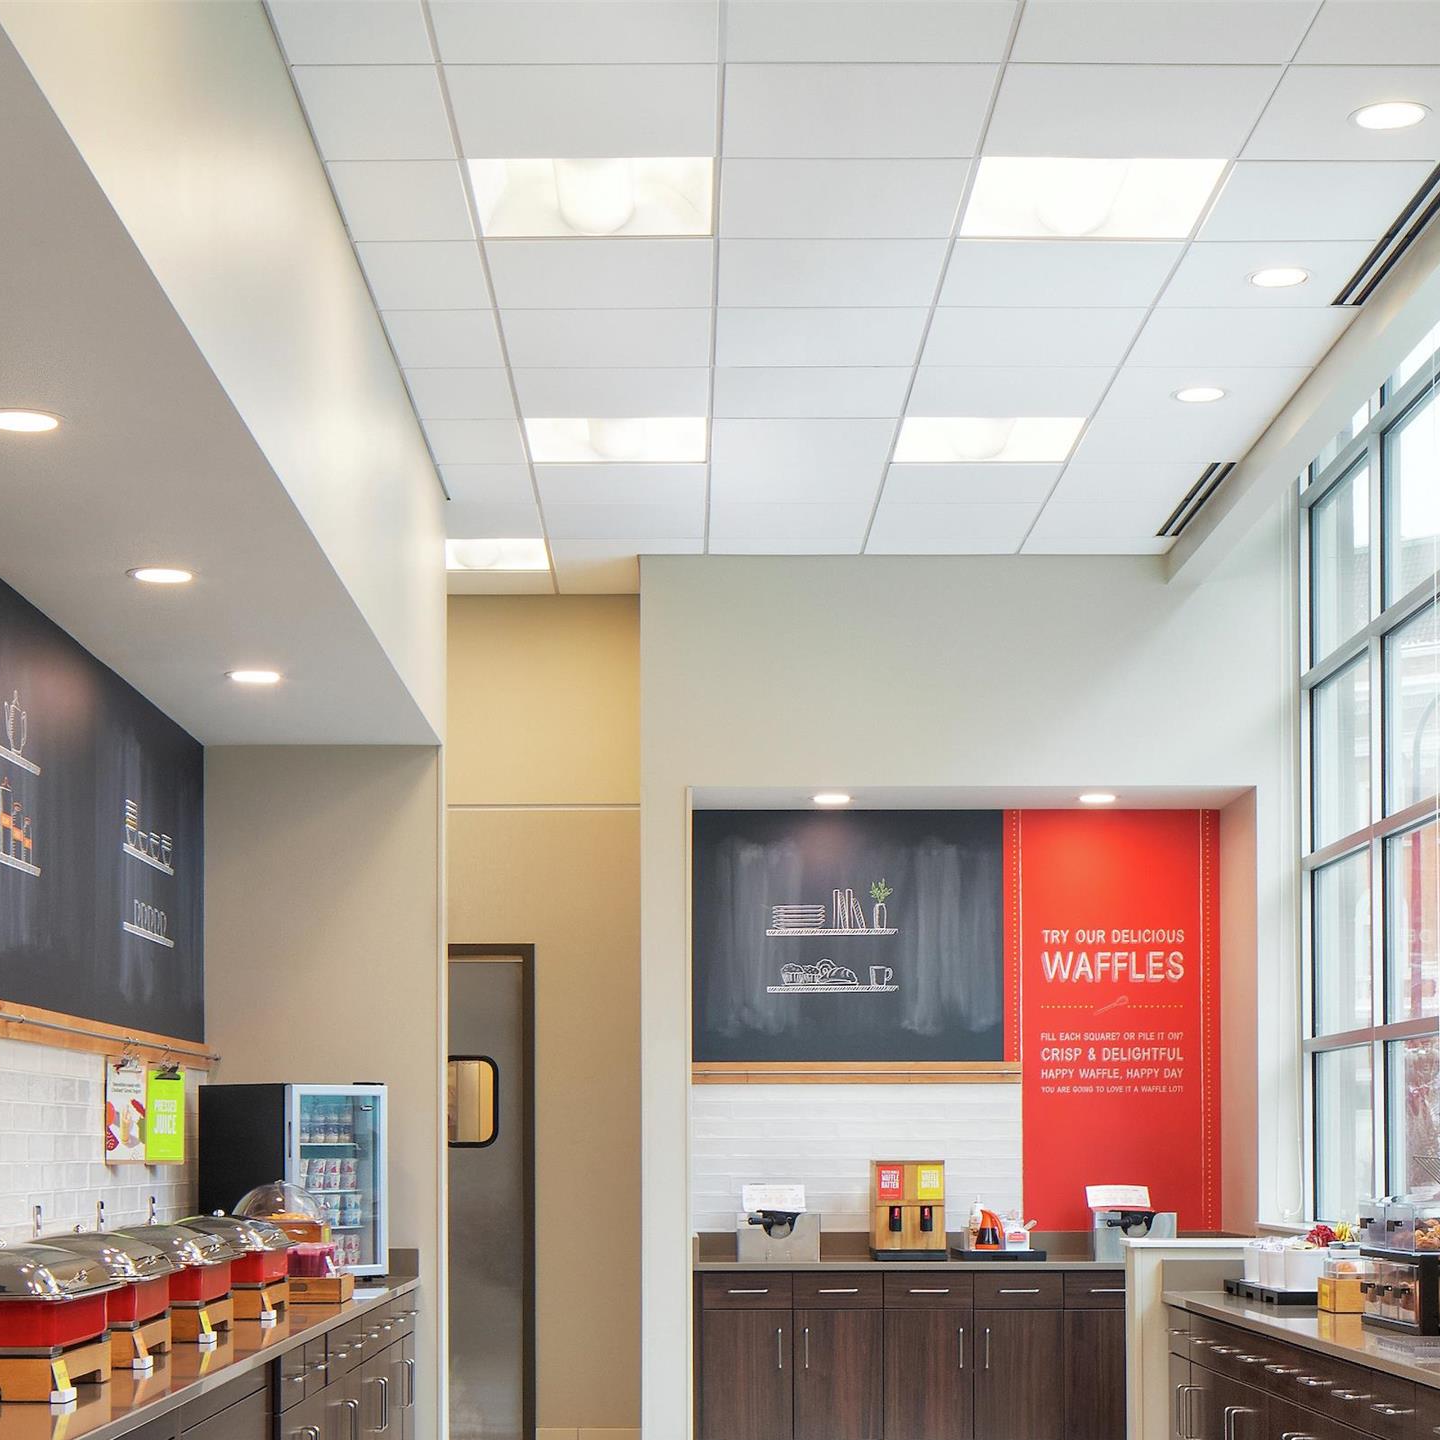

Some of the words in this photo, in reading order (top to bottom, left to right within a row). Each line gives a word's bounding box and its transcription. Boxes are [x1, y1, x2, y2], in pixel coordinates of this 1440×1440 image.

[1041, 929, 1070, 945] TRY
[1075, 929, 1106, 945] OUR
[1110, 929, 1185, 944] DELICIOUS
[1041, 951, 1186, 984] WAFFLES
[1040, 1032, 1056, 1041] FILL
[1059, 1032, 1081, 1041] EACH
[1083, 1032, 1121, 1041] SQUARE?
[1123, 1032, 1136, 1041] OR
[1138, 1032, 1155, 1041] PILE
[1157, 1032, 1165, 1041] IT
[1167, 1032, 1184, 1041] ON?
[1040, 1047, 1082, 1062] CRISP
[1087, 1047, 1097, 1062] &
[1102, 1046, 1184, 1062] DELIGHTFUL
[1041, 1068, 1075, 1079] HAPPY
[1078, 1068, 1123, 1080] WAFFLE,
[1126, 1067, 1160, 1079] HAPPY
[1163, 1067, 1184, 1079] DAY
[1041, 1085, 1055, 1094] YOU
[1057, 1085, 1071, 1093] ARE
[1072, 1085, 1094, 1093] GOING
[1095, 1085, 1105, 1093] TO
[1106, 1085, 1124, 1093] LOVE
[1124, 1085, 1132, 1093] IT
[1133, 1085, 1139, 1093] A
[1140, 1085, 1167, 1093] WAFFLE
